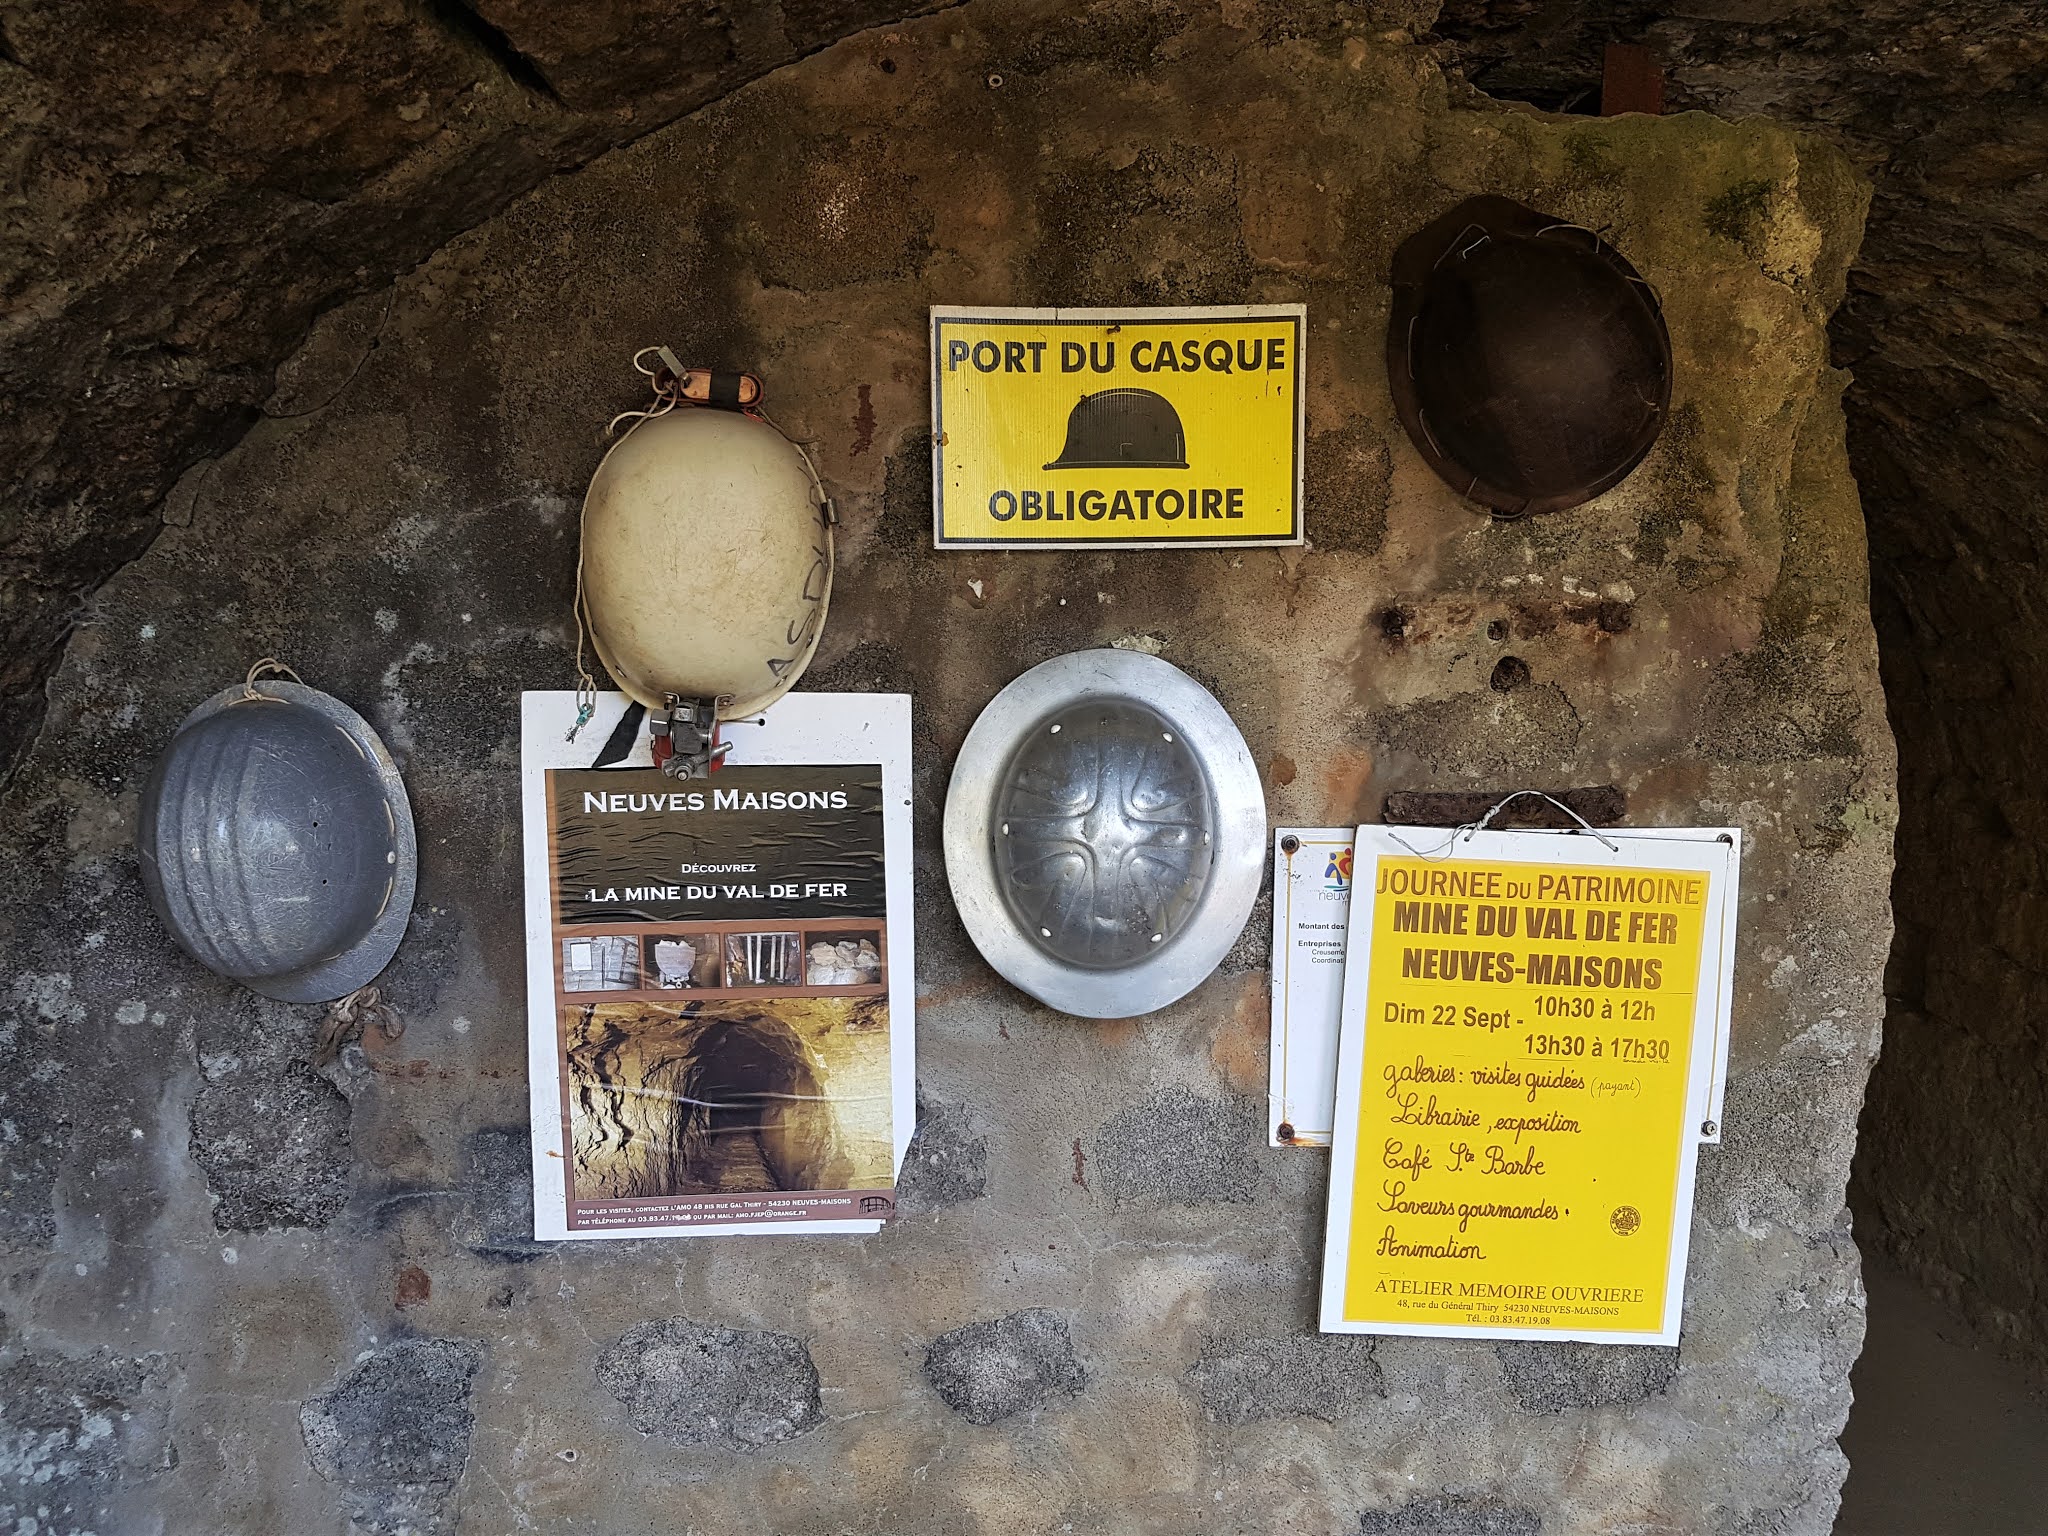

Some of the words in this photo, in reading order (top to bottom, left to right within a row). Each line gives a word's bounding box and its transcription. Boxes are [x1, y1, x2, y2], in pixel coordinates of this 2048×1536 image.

[949, 340, 1047, 373] PORT
[1061, 341, 1116, 373] DU
[1130, 338, 1286, 374] CASQUE
[988, 488, 1244, 522] OBLIGATOIRE
[583, 790, 705, 813] NEUVES
[713, 788, 849, 811] MAISONS
[681, 862, 757, 874] DÉCOUVREZ
[590, 887, 620, 903] LA
[625, 886, 681, 901] MINE
[687, 885, 716, 900] DU
[722, 884, 764, 899] VAL
[770, 883, 799, 899] DE
[805, 882, 849, 898] FER
[1376, 868, 1503, 899] JOURNEE
[1506, 882, 1531, 900] DU
[1537, 874, 1702, 905] PATRIMOINE
[1393, 901, 1469, 935] MINE
[1476, 904, 1517, 938] DU
[1525, 907, 1577, 940] VAL
[1585, 910, 1622, 943] DE
[1628, 911, 1678, 945] FER
[1298, 940, 1342, 948] Entreprises
[1402, 947, 1663, 990] NEUVES-MAISONS
[1384, 1002, 1425, 1025] Dim
[1432, 1005, 1456, 1026] 22
[1463, 1005, 1511, 1033] Sept
[1534, 995, 1595, 1018] 10h30
[1601, 999, 1614, 1020] à
[1620, 1000, 1656, 1021] 12h
[1524, 1034, 1585, 1057] 13h30
[1591, 1037, 1603, 1058] à
[1610, 1037, 1670, 1059] 17h30
[1470, 1061, 1521, 1087] visites
[1525, 1067, 1585, 1102] guidées
[1590, 1076, 1642, 1099] (payant)
[1391, 1092, 1480, 1126] Librairie
[1383, 1137, 1433, 1182] Café
[1481, 1145, 1546, 1176] Barbe
[608, 1206, 634, 1215] VISITES,
[635, 1205, 669, 1213] CONTACTEZ
[792, 1198, 852, 1206] NEUVES-MAISONS
[1377, 1179, 1455, 1215] Saveurs
[1376, 1225, 1487, 1260] Animation
[1374, 1279, 1454, 1296] ATELIER
[1458, 1283, 1547, 1299] MEMOIRE
[1551, 1287, 1644, 1303] OUVRIERE
[1396, 1300, 1410, 1310] 48,
[1429, 1301, 1439, 1310] du
[1441, 1301, 1474, 1312] Général
[1476, 1302, 1499, 1314] Thiry
[1503, 1303, 1530, 1313] 54230
[1531, 1304, 1619, 1316] NEUVES-MAISONS
[1489, 1315, 1551, 1326] 03.83.47.19.08
